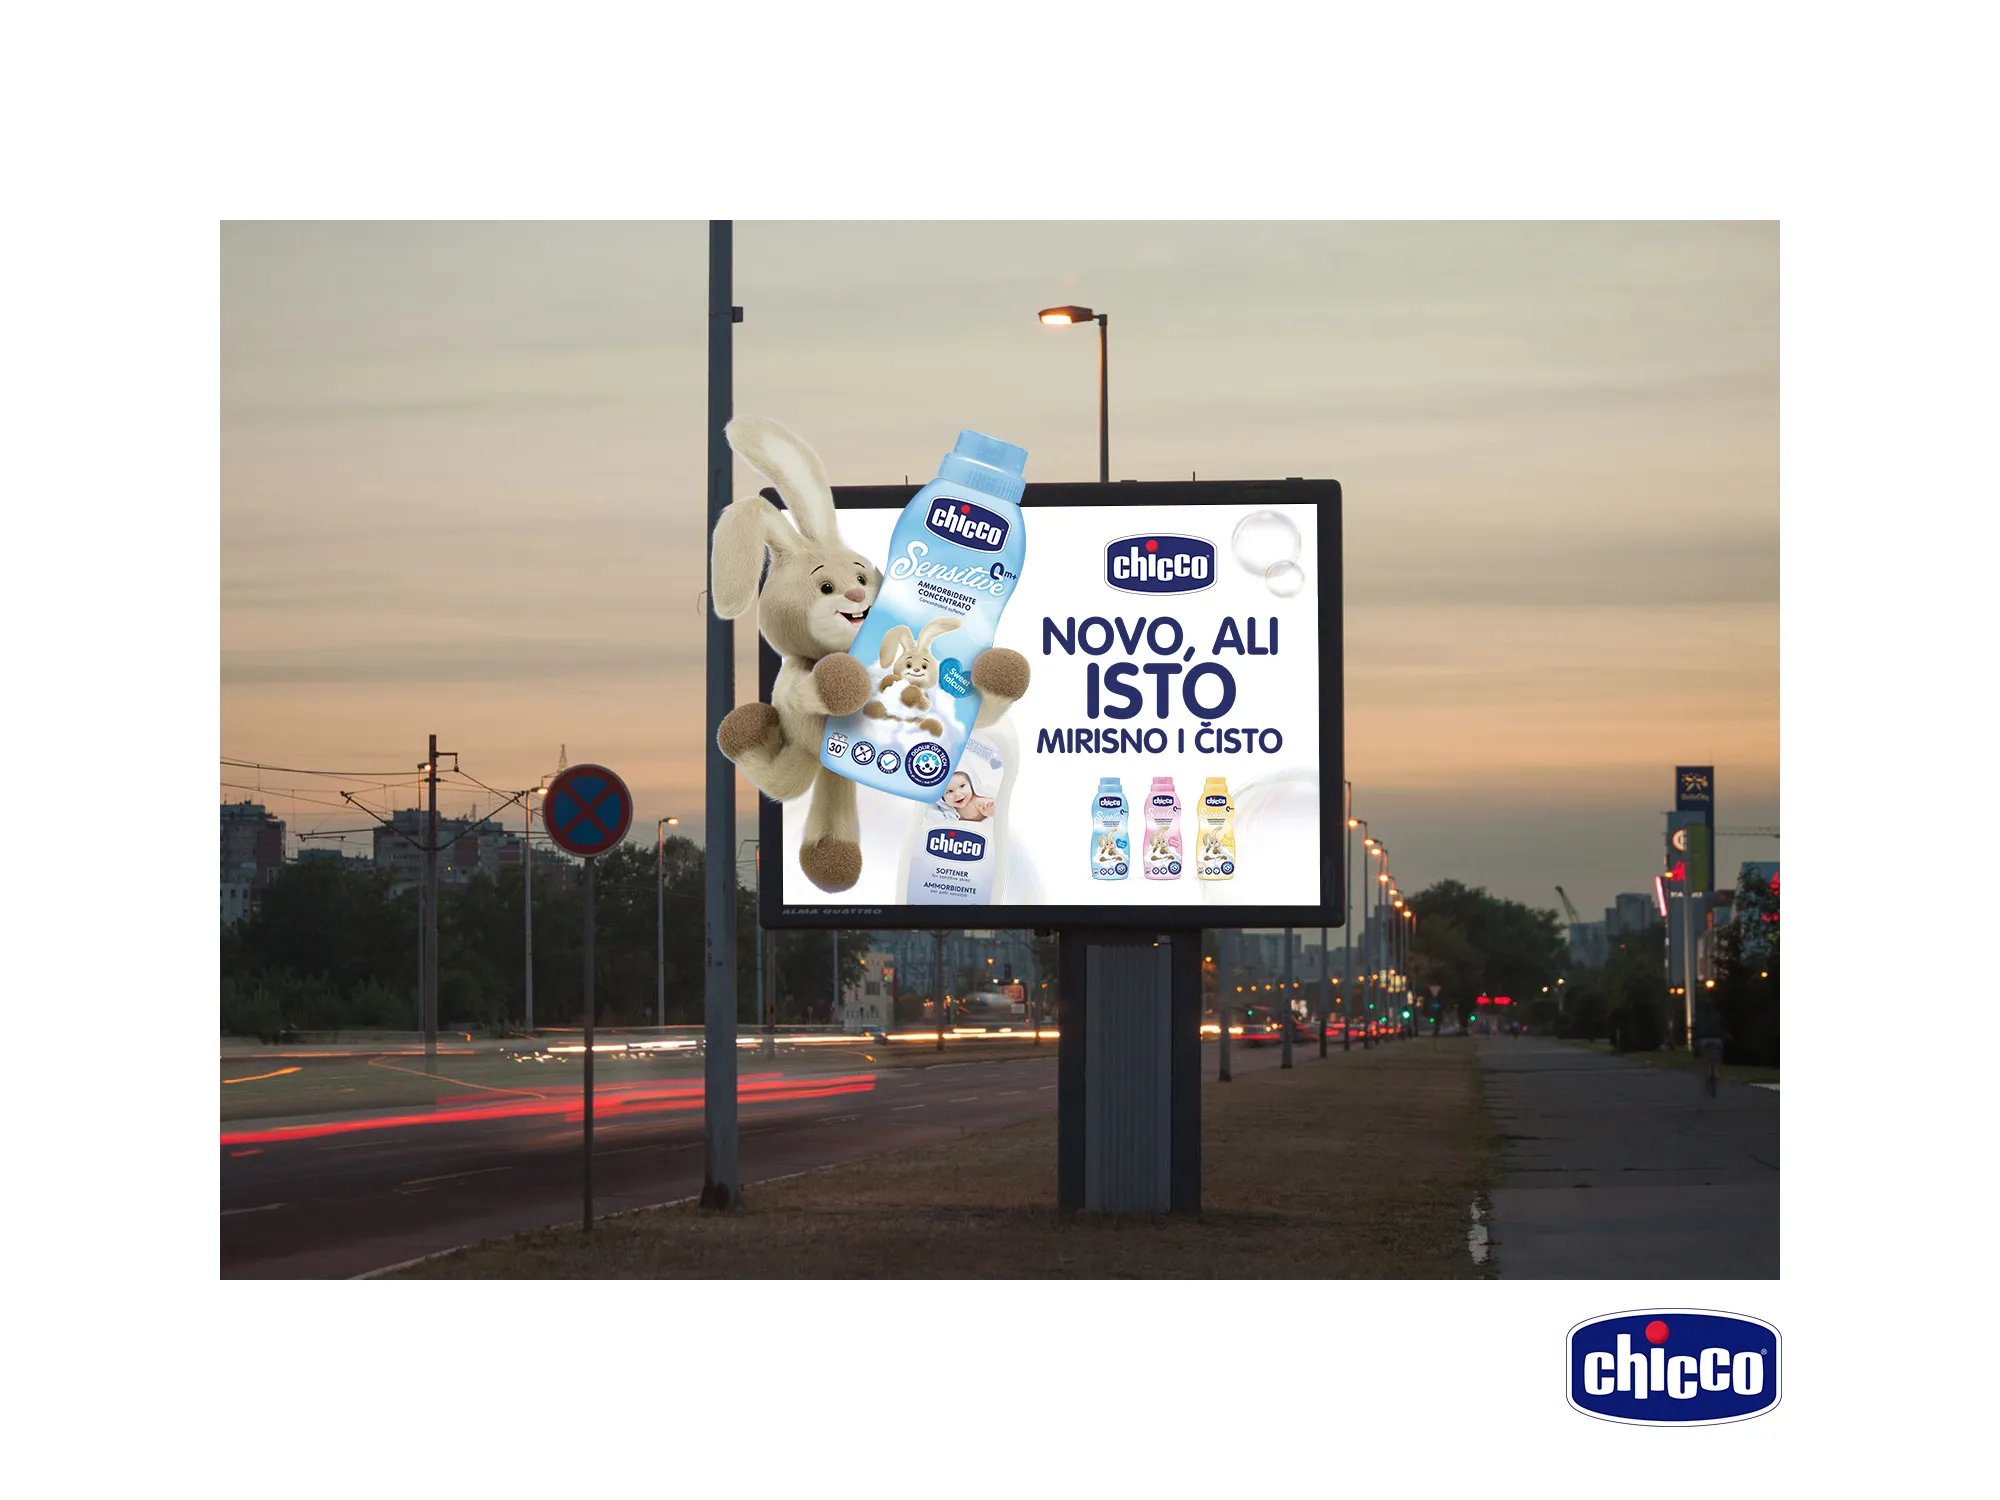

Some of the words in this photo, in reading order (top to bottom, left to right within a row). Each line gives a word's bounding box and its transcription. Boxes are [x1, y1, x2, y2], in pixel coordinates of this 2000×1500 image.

[931, 504, 1002, 545] chicco
[889, 540, 1005, 597] Sensitive
[1113, 539, 1209, 582] chicco
[917, 580, 977, 605] AMMORBIDENTE
[918, 588, 971, 611] CONCENTRATO
[1043, 616, 1195, 662] NOVO,
[1212, 616, 1278, 655] ALI
[943, 674, 966, 694] talcum
[949, 668, 971, 687] Sweet
[1087, 662, 1236, 719] ISTO
[1037, 728, 1168, 754] MIRISNO
[1178, 728, 1185, 754] I
[1195, 721, 1283, 754] ČISTO
[929, 831, 982, 856] chicco
[936, 867, 969, 878] SOFTENER
[923, 881, 977, 895] AMMORBIDENTE
